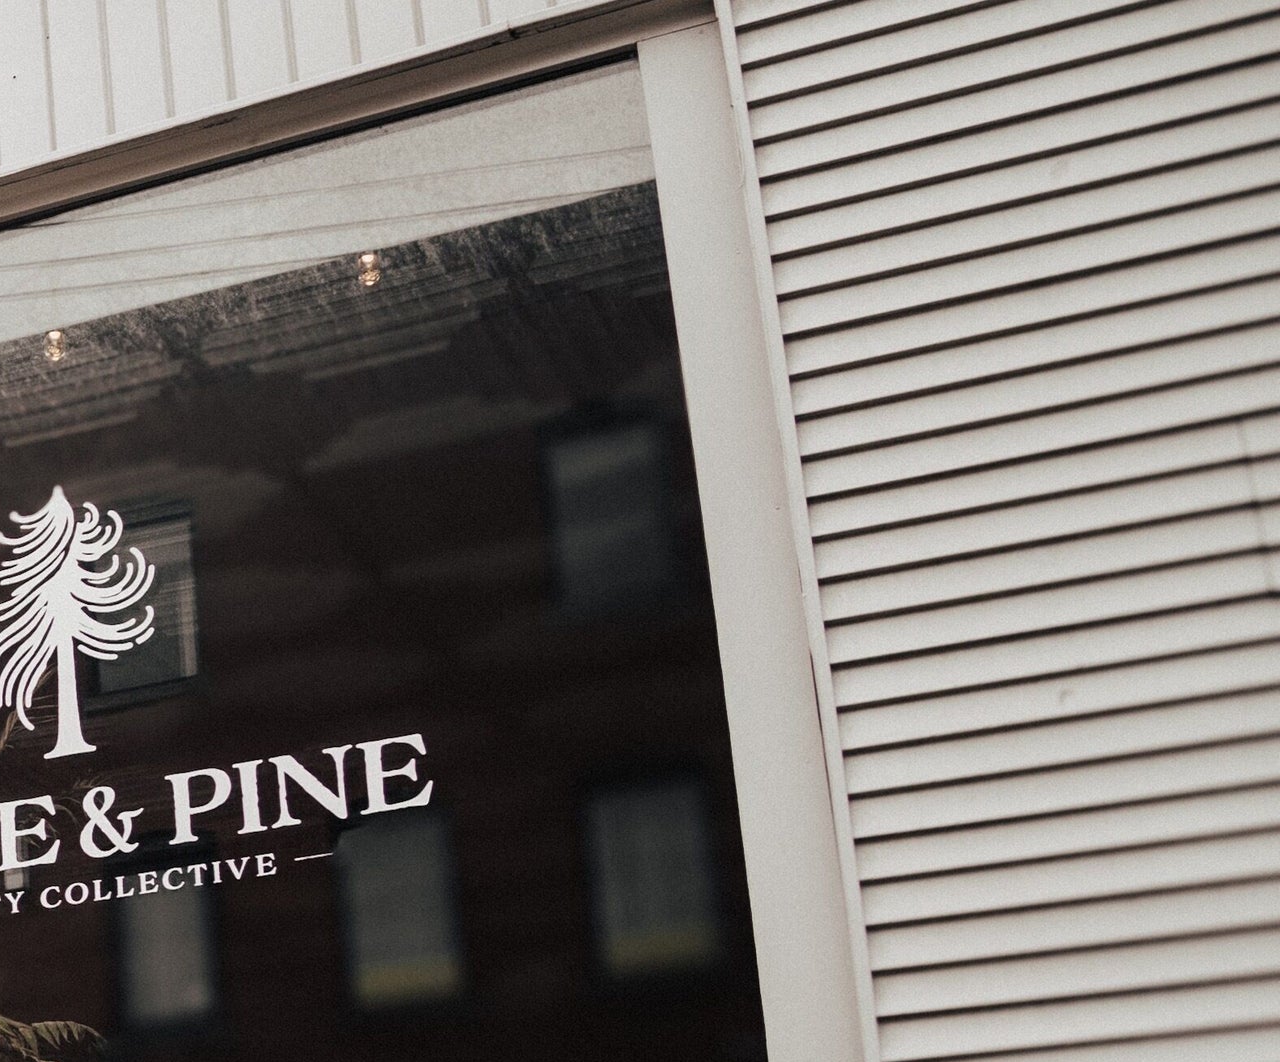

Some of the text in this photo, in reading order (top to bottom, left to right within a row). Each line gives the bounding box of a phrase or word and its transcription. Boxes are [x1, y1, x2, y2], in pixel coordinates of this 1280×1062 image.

[79, 786, 144, 858] &
[164, 733, 434, 845] PINE
[39, 852, 277, 910] COLLECTIVE
